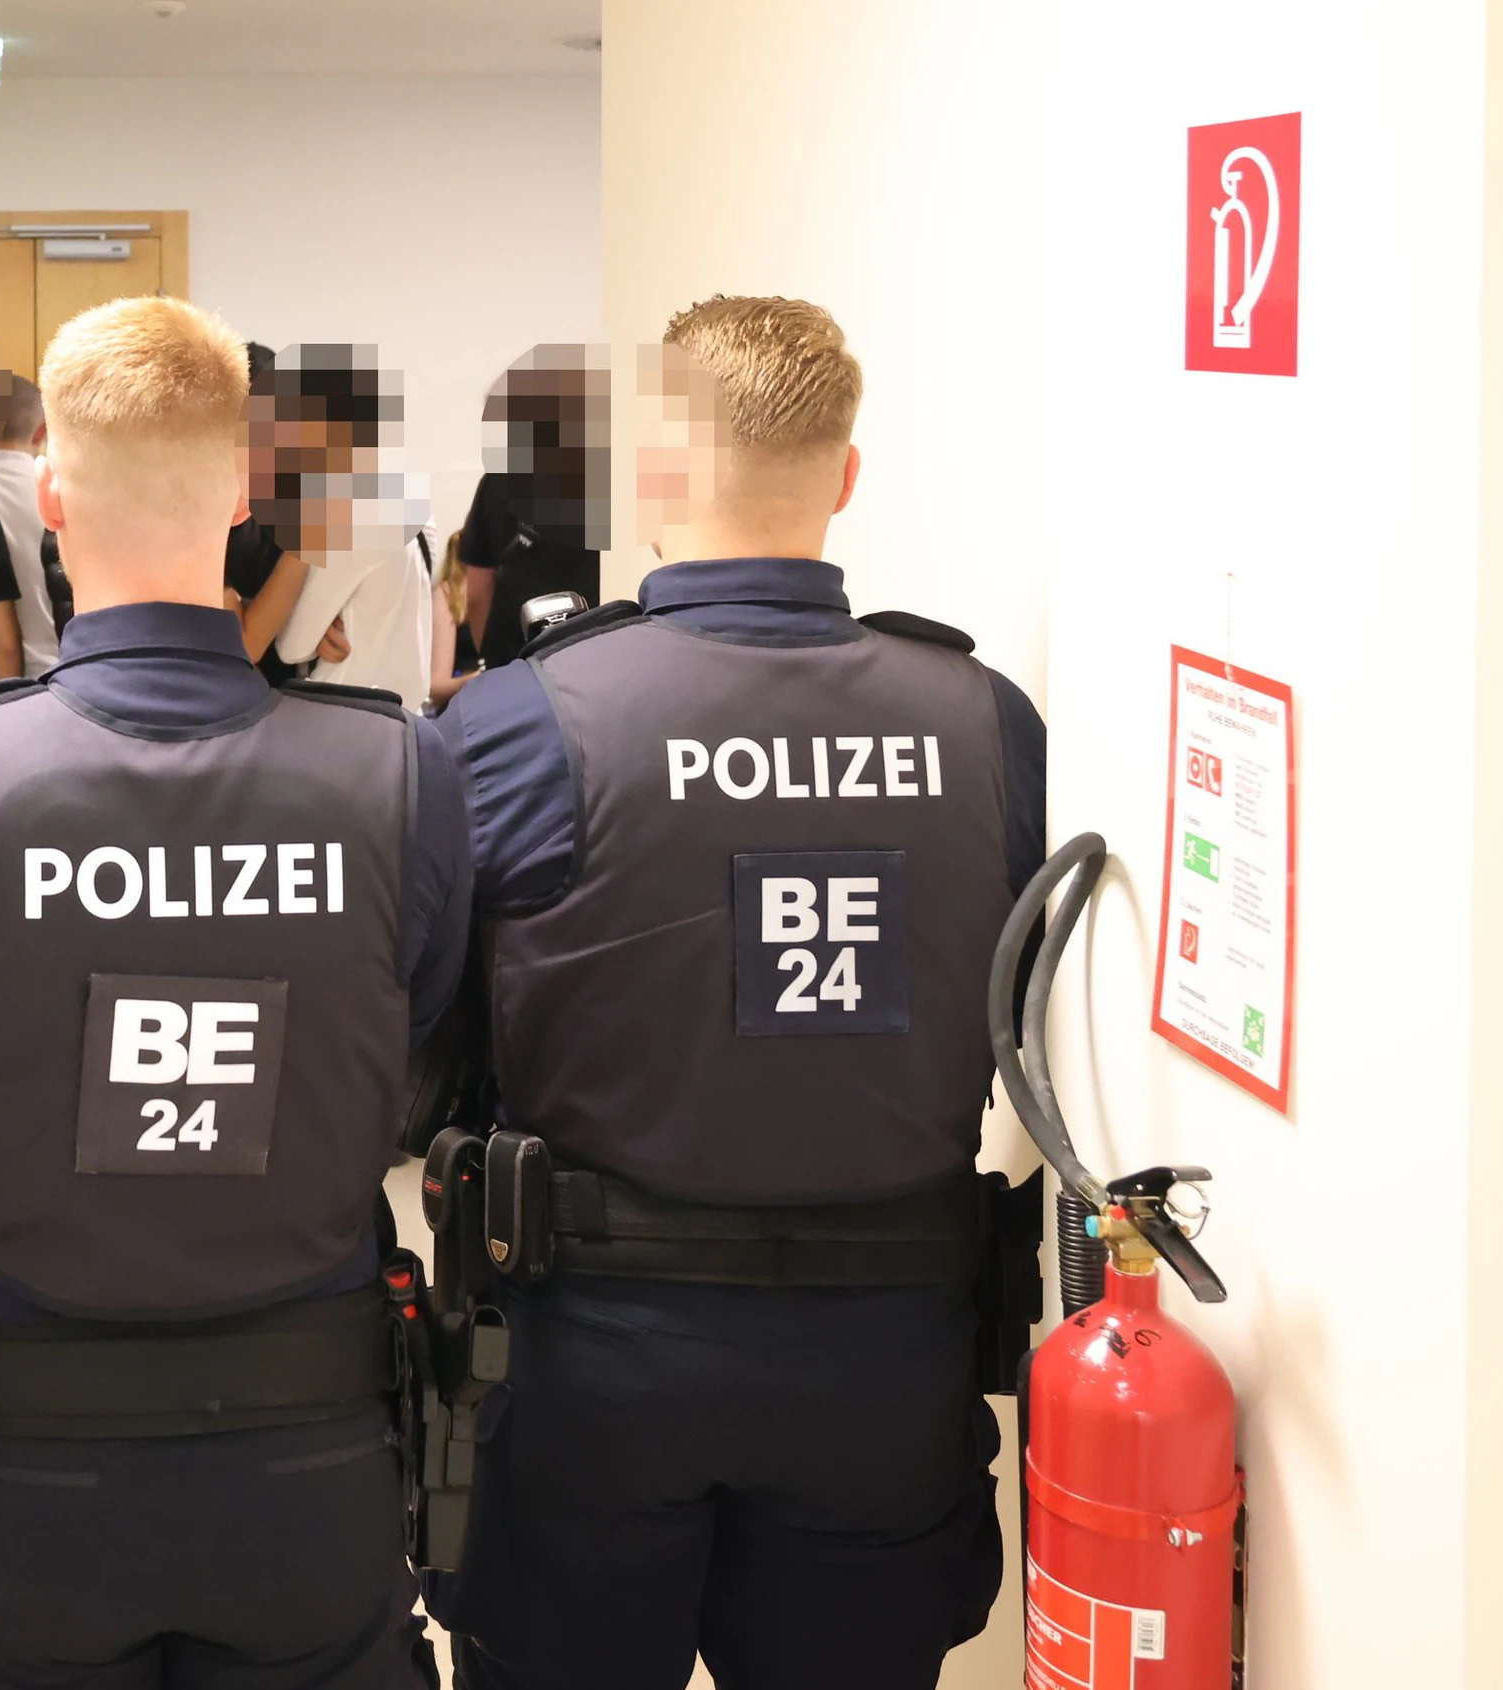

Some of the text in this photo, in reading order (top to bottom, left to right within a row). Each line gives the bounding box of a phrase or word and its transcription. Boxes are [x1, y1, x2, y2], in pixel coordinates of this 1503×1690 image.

[667, 736, 942, 800] POLIZEI
[25, 843, 343, 919] POLIZEI
[762, 878, 879, 942] BE
[776, 947, 861, 1012] 24
[109, 999, 258, 1084] BE
[137, 1099, 218, 1150] 24
